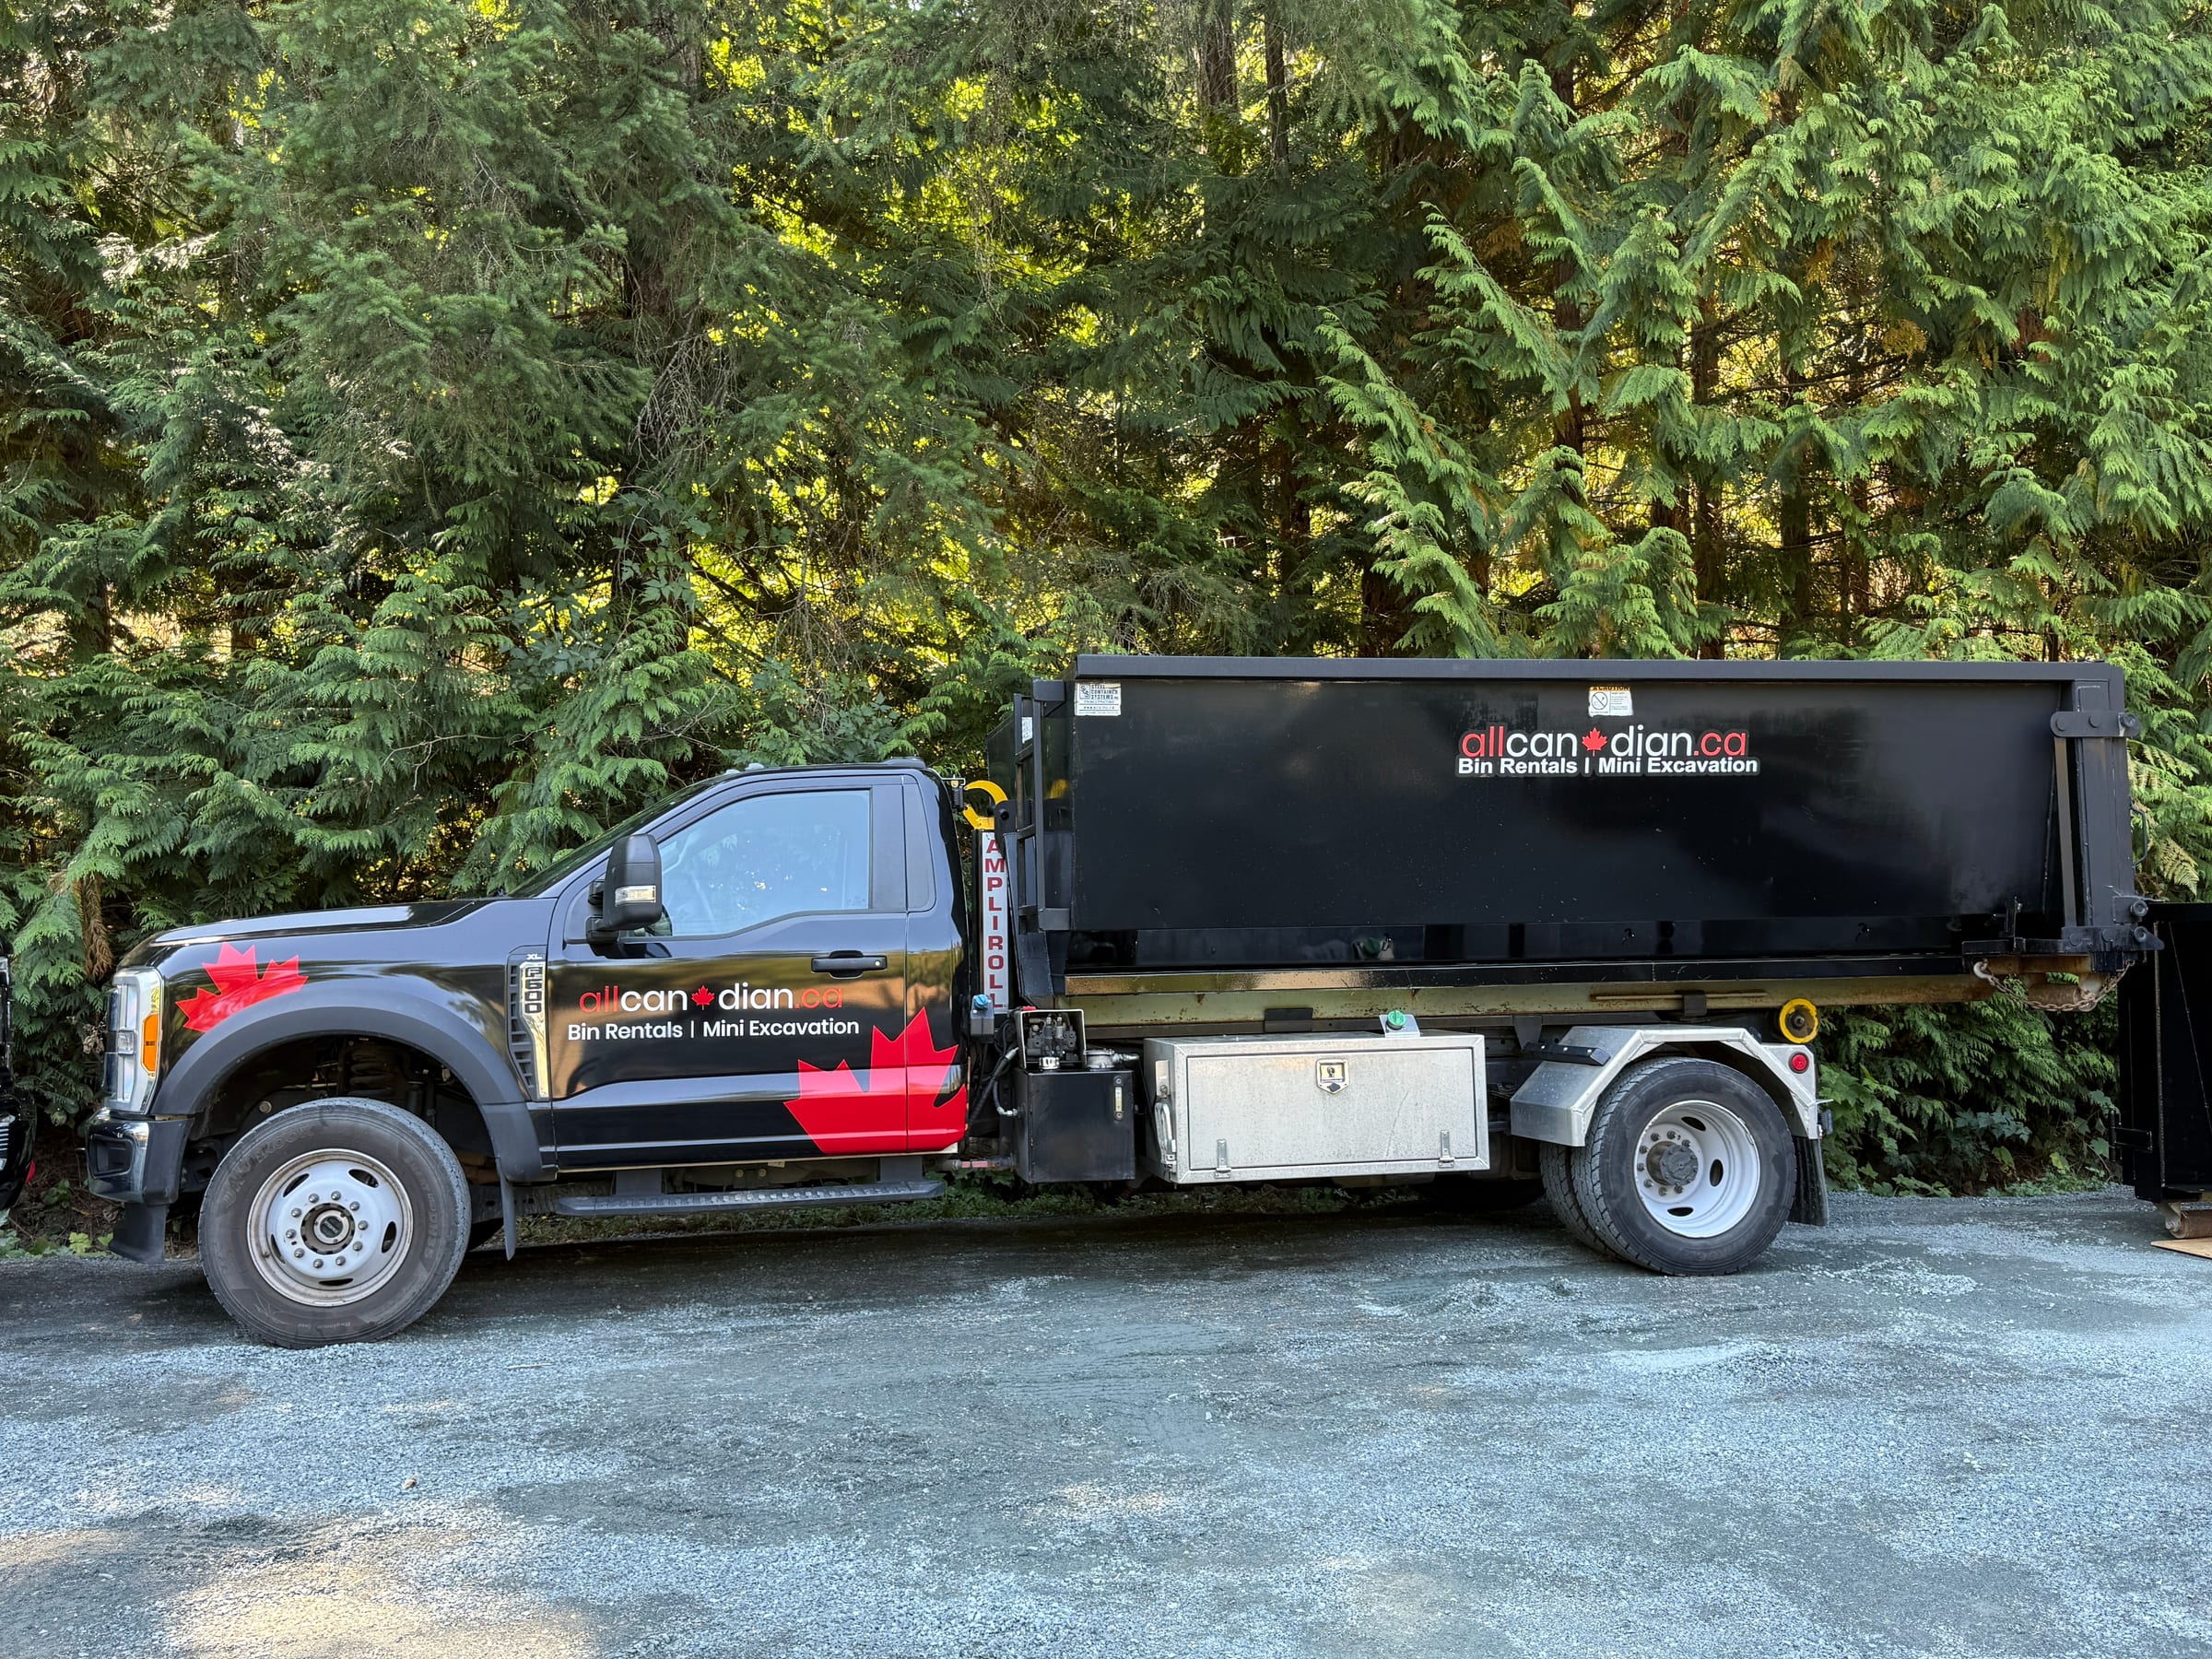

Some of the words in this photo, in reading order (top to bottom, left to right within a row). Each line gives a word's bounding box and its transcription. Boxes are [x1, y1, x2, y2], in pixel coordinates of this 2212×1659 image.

[1458, 758, 1493, 774] Bin
[1500, 758, 1578, 774] Rentals
[1598, 757, 1641, 773] Mini
[1647, 757, 1758, 773] Excavation
[984, 840, 1006, 1008] AMPLIROLL
[524, 966, 543, 1014] F600
[568, 1022, 600, 1041] Bin
[606, 1021, 683, 1040] Rentals
[703, 1019, 745, 1037] Mini
[749, 1018, 860, 1036] Excavation
